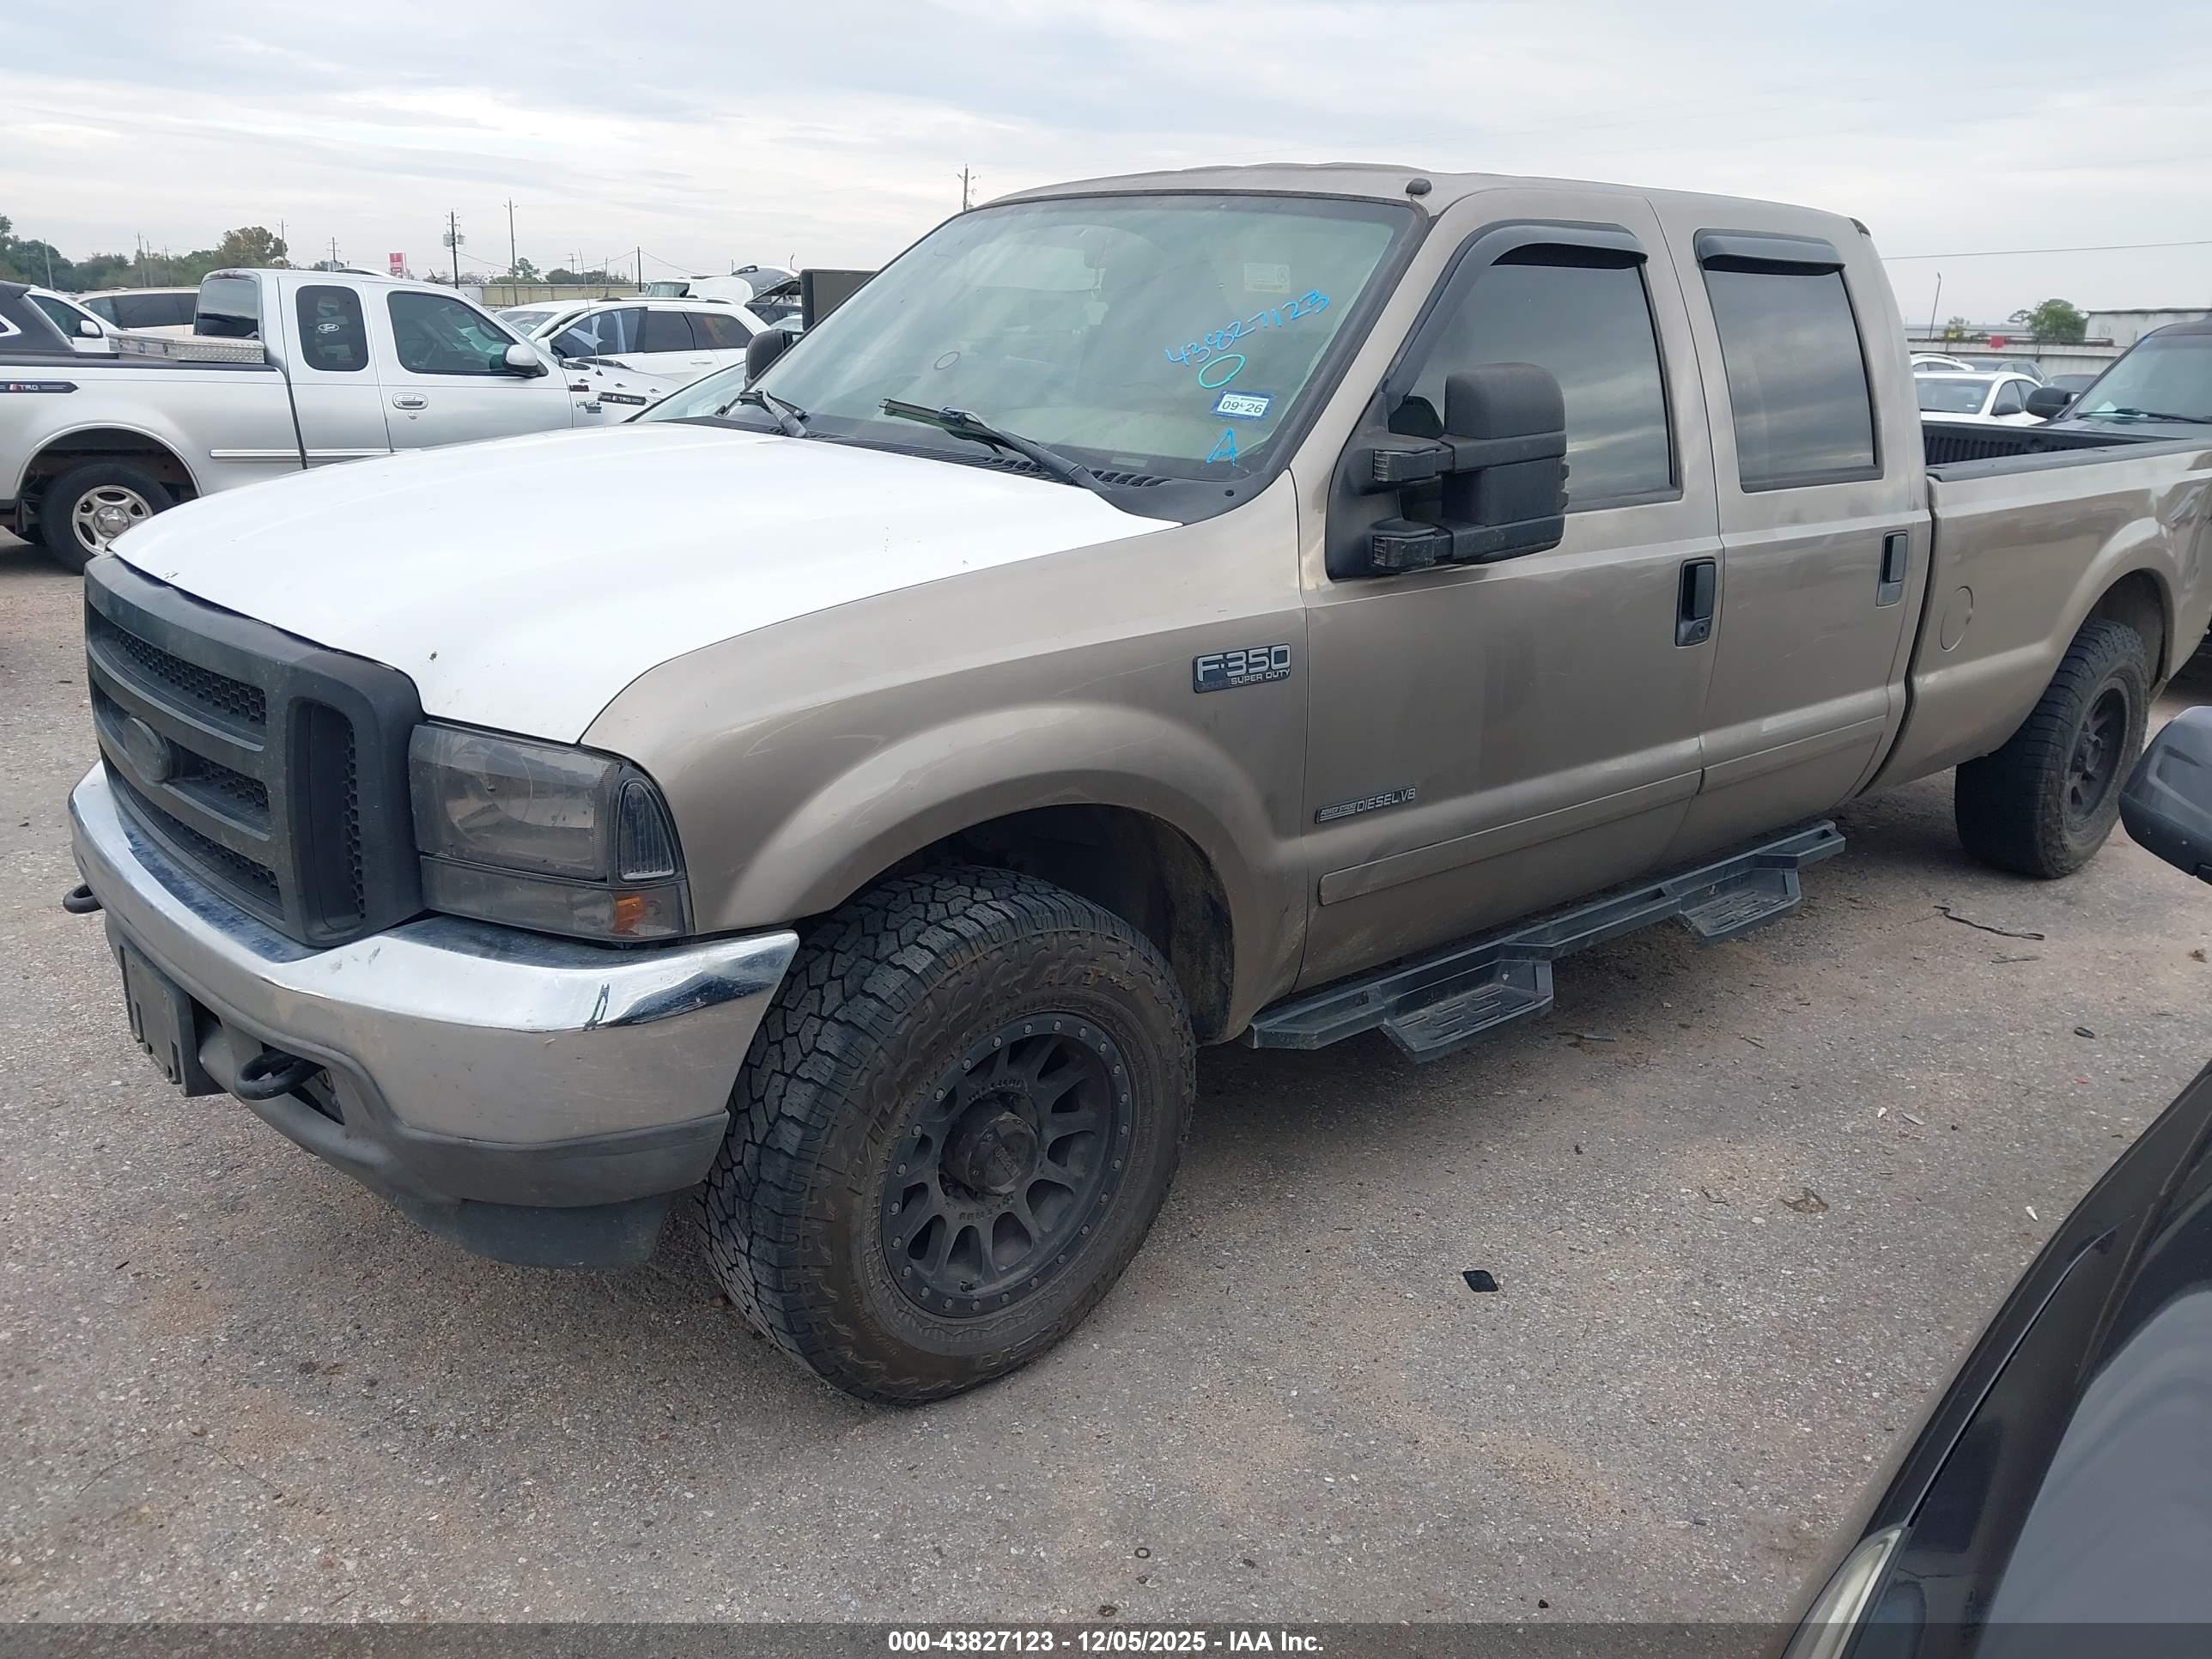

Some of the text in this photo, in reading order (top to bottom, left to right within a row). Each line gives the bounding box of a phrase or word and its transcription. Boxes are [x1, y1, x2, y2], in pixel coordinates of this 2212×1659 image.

[1165, 289, 1330, 366] 43827123
[1231, 673, 1263, 685] SUPER
[1265, 668, 1291, 679] DUTY
[1356, 793, 1399, 812] DIESEL
[1401, 787, 1416, 803] V8
